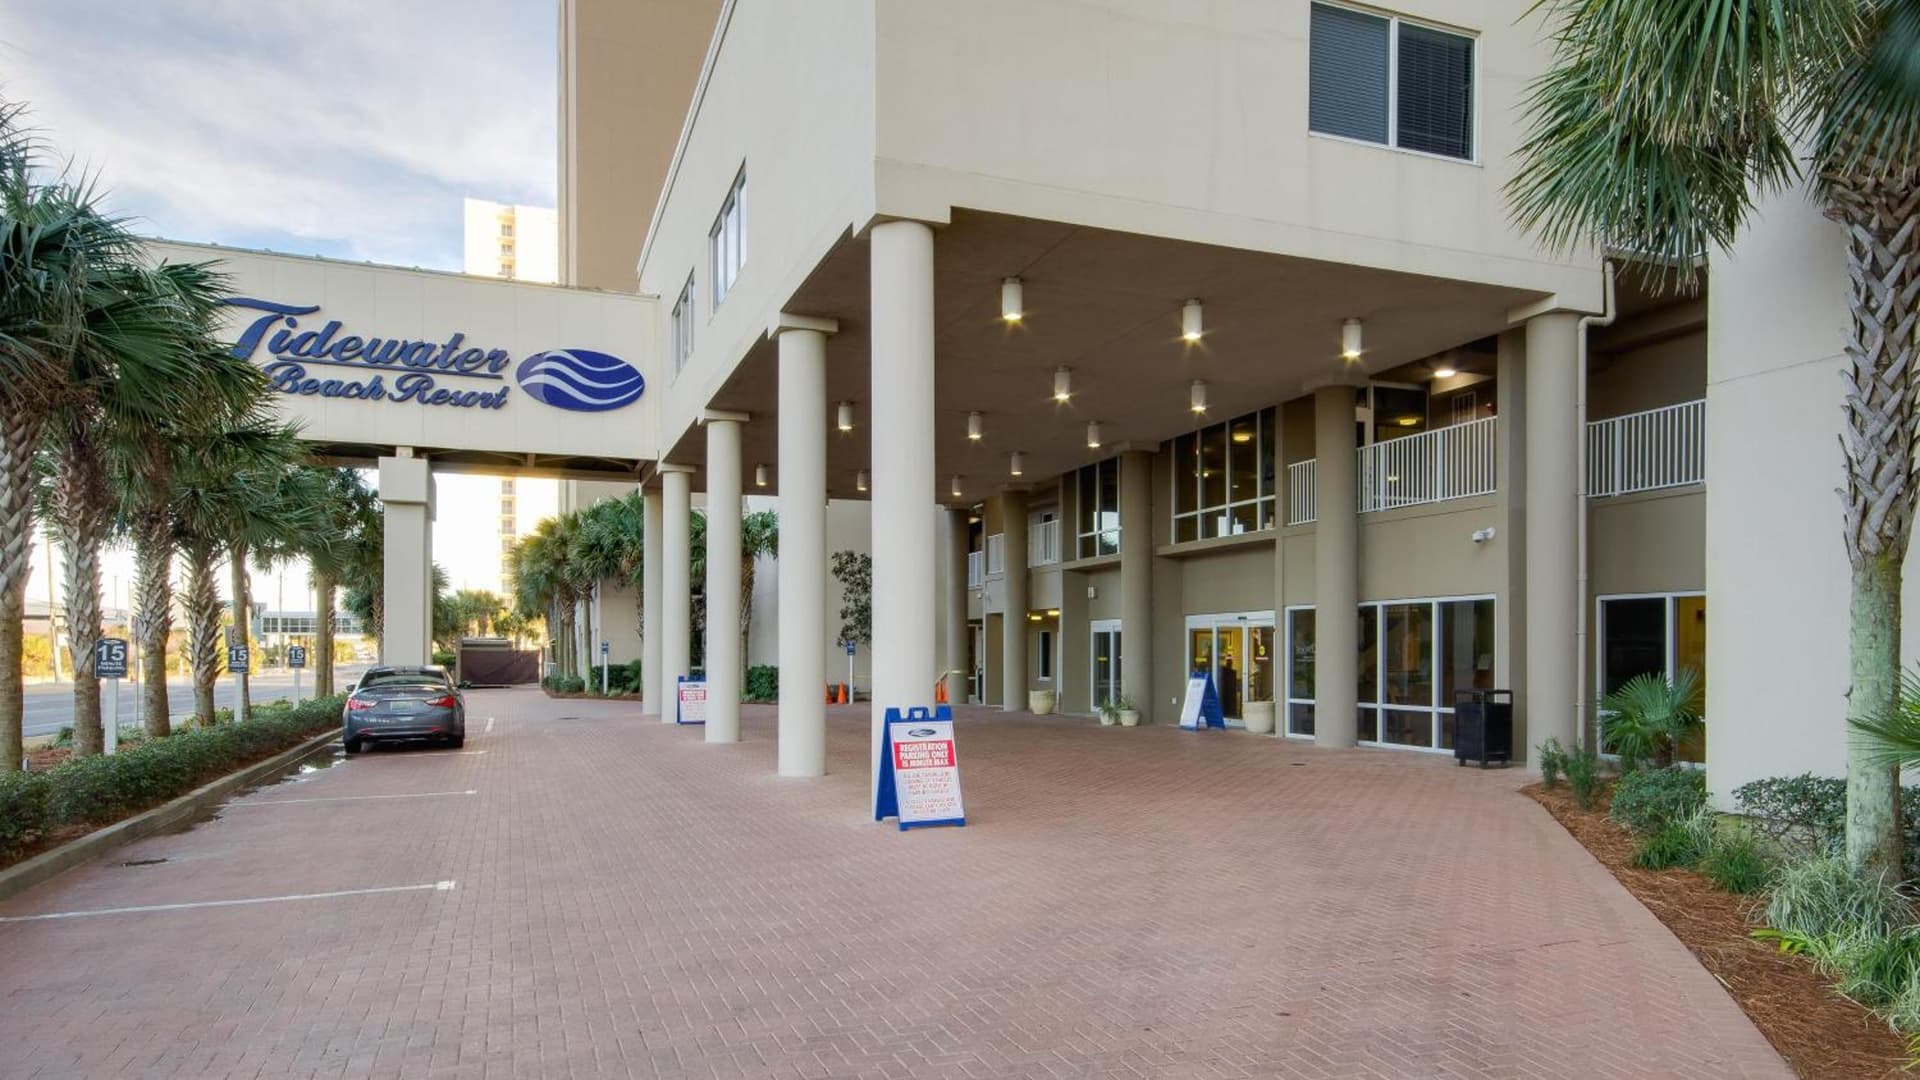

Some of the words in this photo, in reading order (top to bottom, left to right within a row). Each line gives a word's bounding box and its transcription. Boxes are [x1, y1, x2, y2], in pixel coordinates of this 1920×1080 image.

[215, 296, 510, 374] Tidewater
[263, 362, 386, 400] Beach
[388, 372, 510, 410] Resort
[97, 644, 125, 661] 15
[230, 649, 248, 661] 15
[290, 649, 304, 659] 15
[900, 742, 948, 752] REGISTRATION
[931, 751, 948, 759] ONLY
